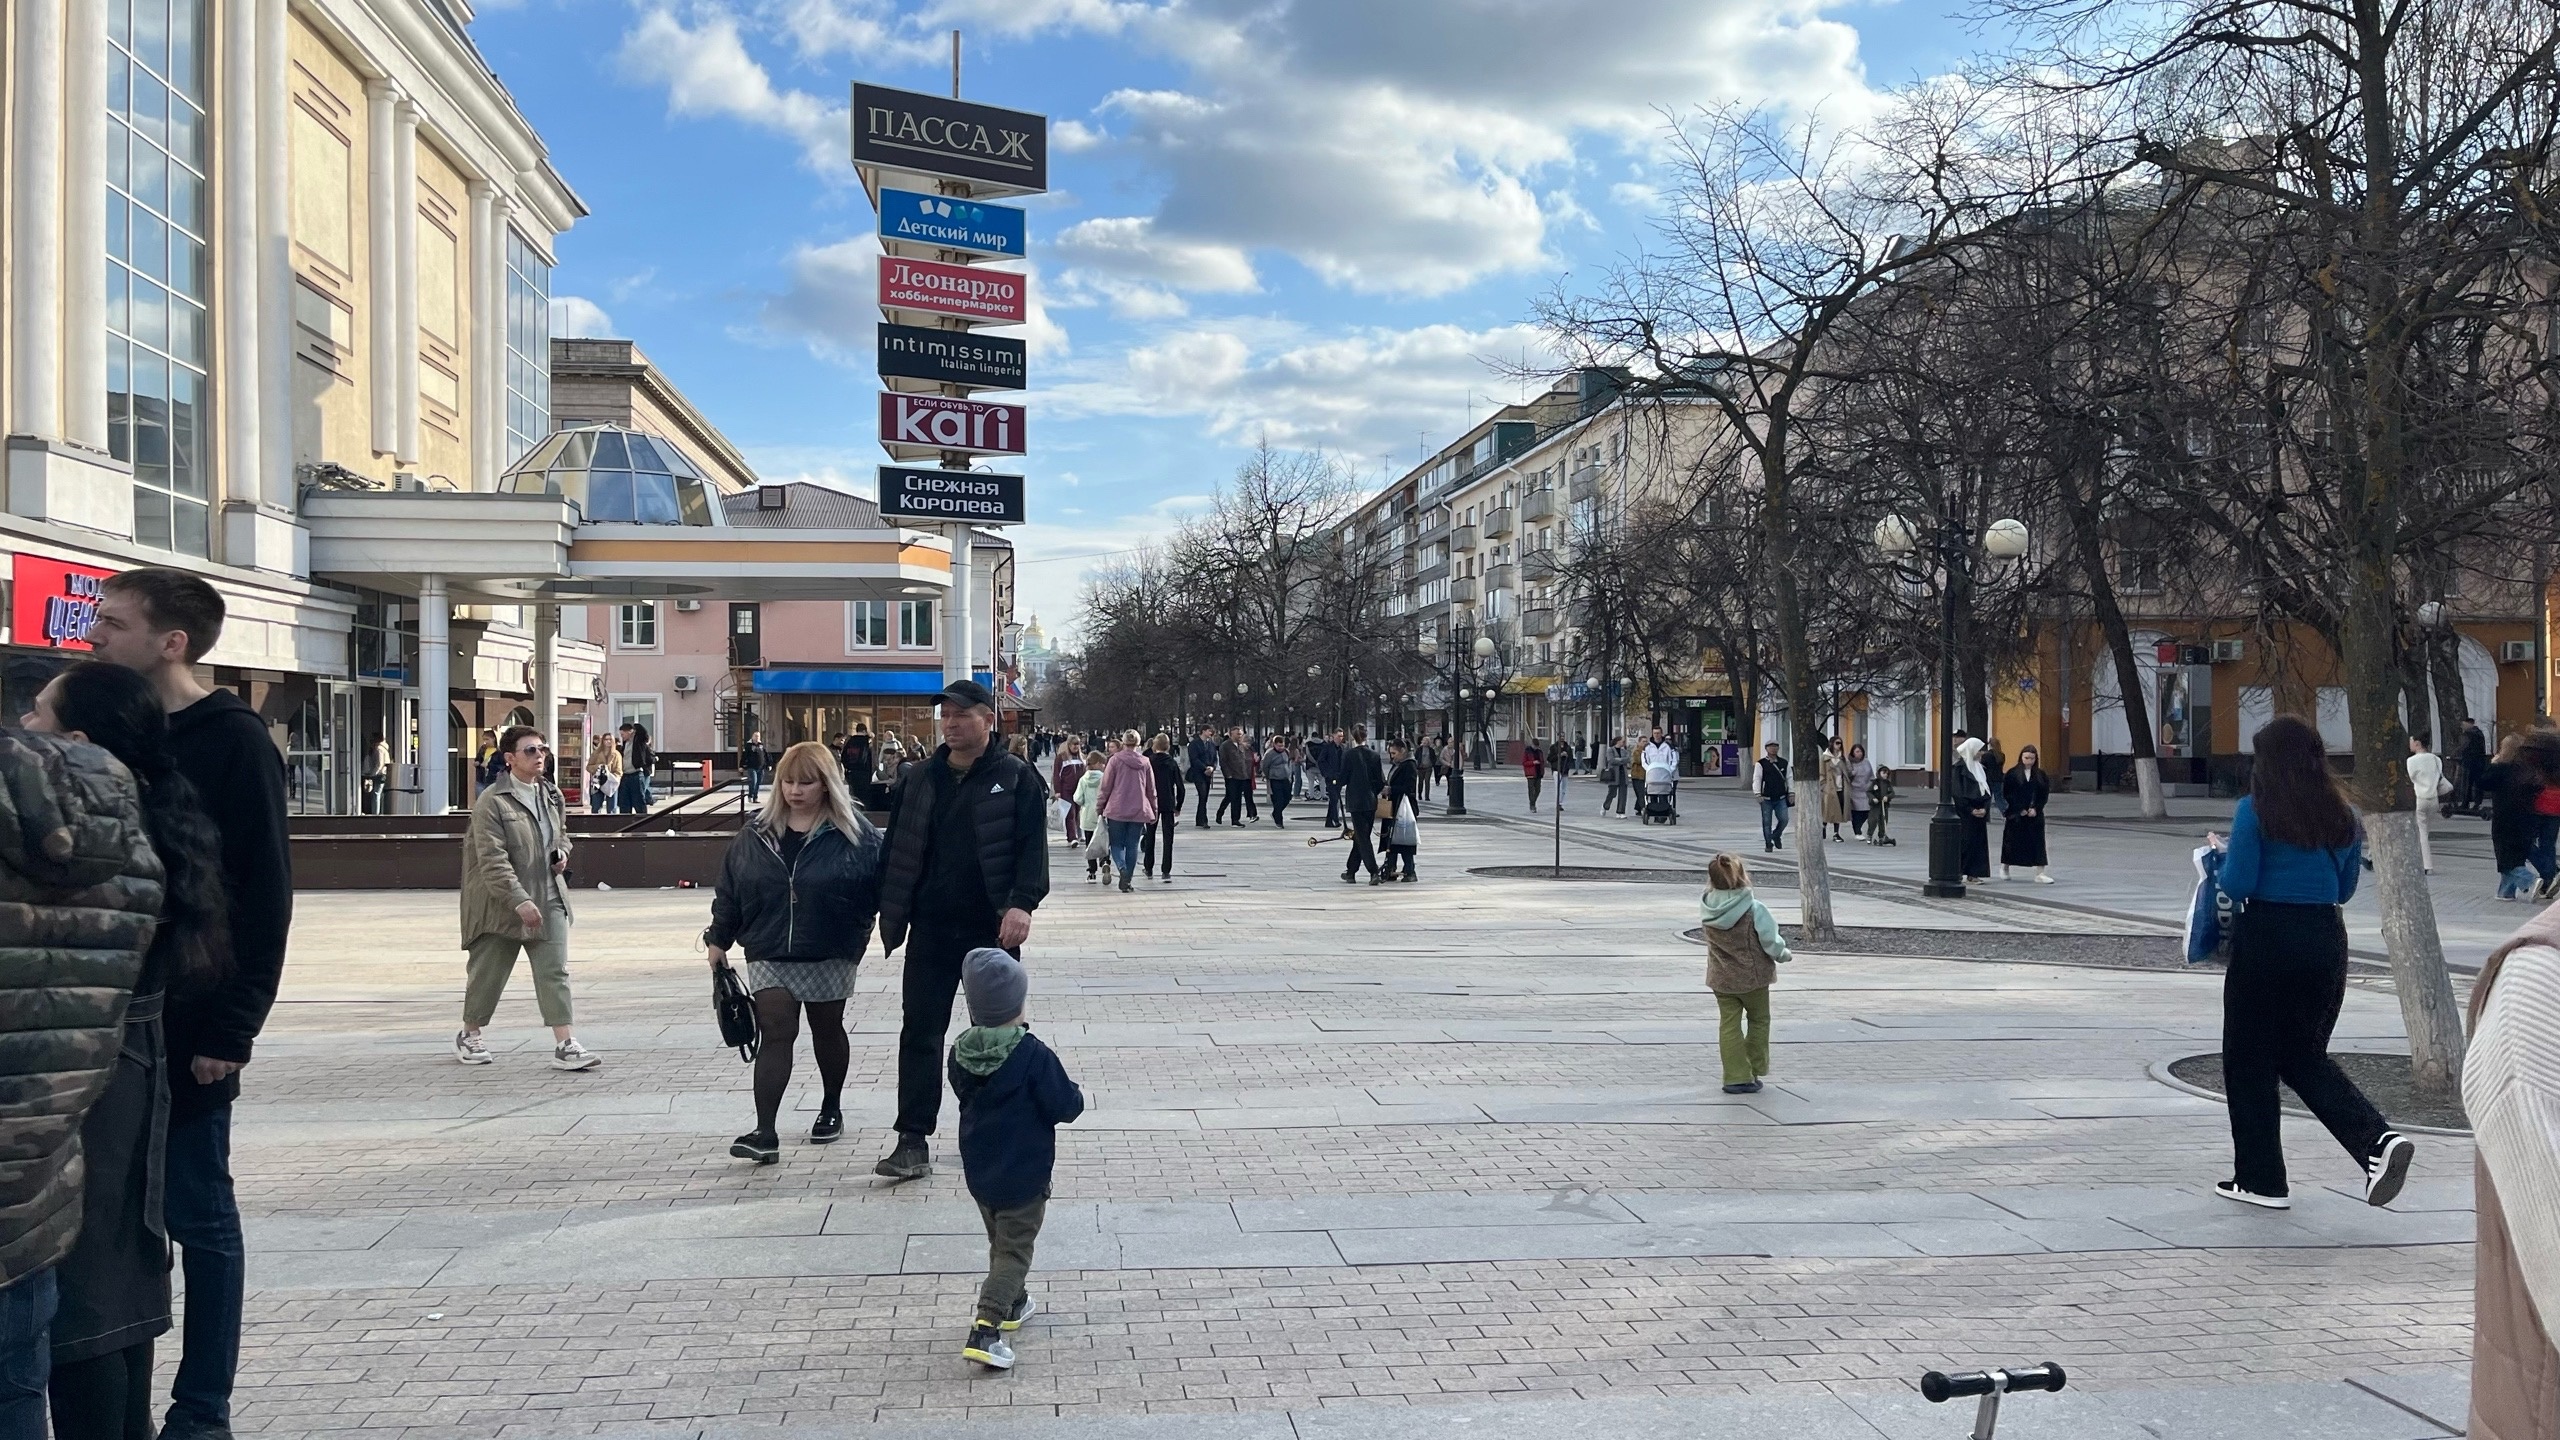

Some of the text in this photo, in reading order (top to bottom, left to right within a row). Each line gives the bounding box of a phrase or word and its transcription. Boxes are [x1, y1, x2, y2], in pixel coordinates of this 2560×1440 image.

[868, 106, 1034, 162] ПАССАЖ
[897, 216, 1007, 251] Детский мир
[889, 264, 1015, 301] Леонардо
[890, 289, 1015, 313] хобби-гипермаркет
[884, 336, 1022, 365] intimissimi
[941, 358, 1021, 376] Italian lingerie
[913, 398, 984, 413] ЕСЛИ ОБУВЬ, ТО
[897, 397, 1010, 449] kari
[905, 475, 999, 496] Снежная
[900, 494, 1005, 514] Королева
[49, 596, 101, 647] ЦЕН
